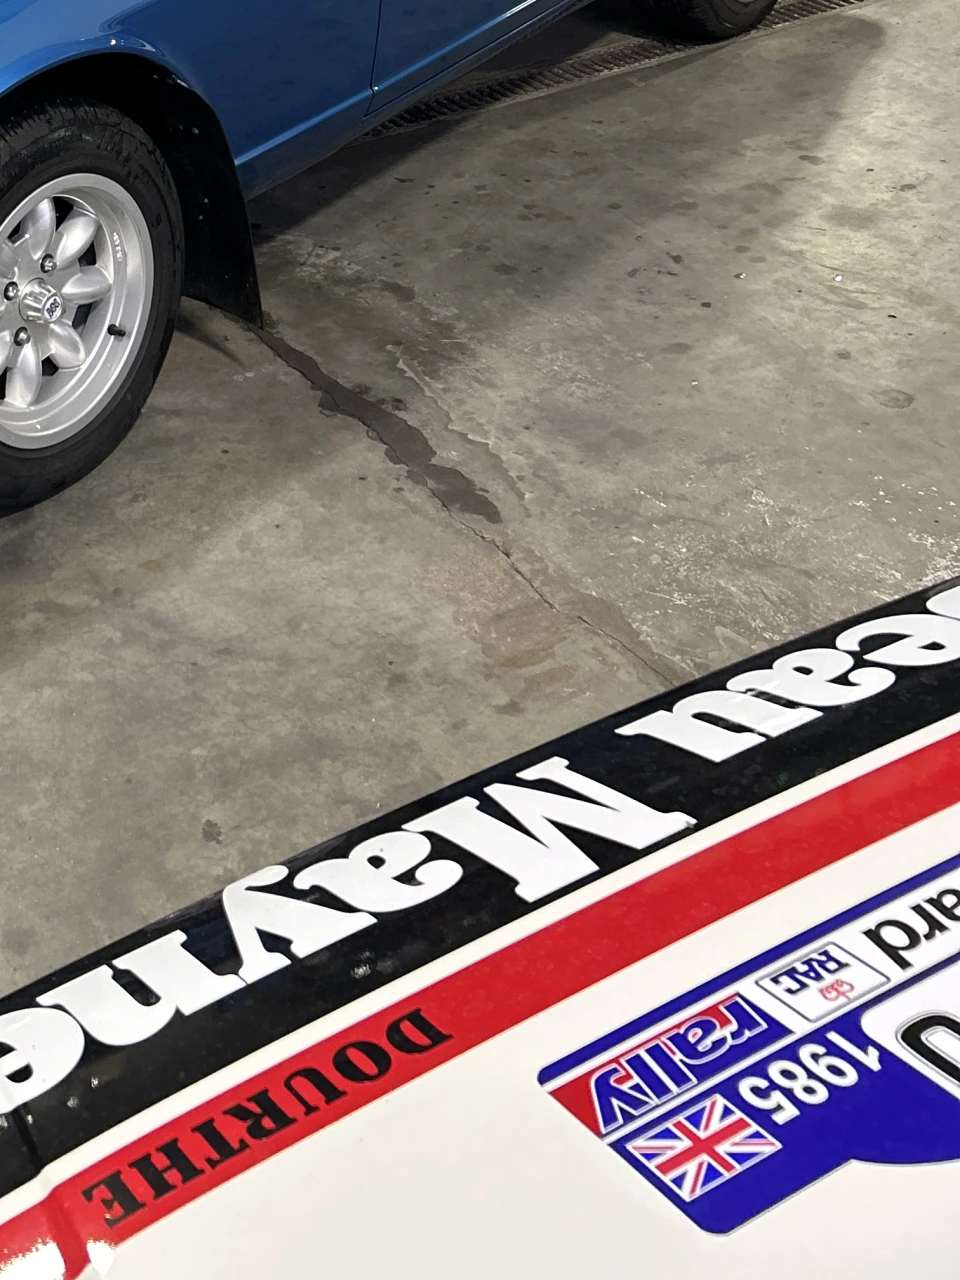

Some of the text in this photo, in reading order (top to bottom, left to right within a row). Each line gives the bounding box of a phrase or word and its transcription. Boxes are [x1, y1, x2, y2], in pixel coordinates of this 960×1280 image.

[780, 949, 849, 997] RAC
[81, 1006, 454, 1230] DOURTHE
[594, 992, 769, 1131] rally
[738, 1029, 882, 1126] 1985
